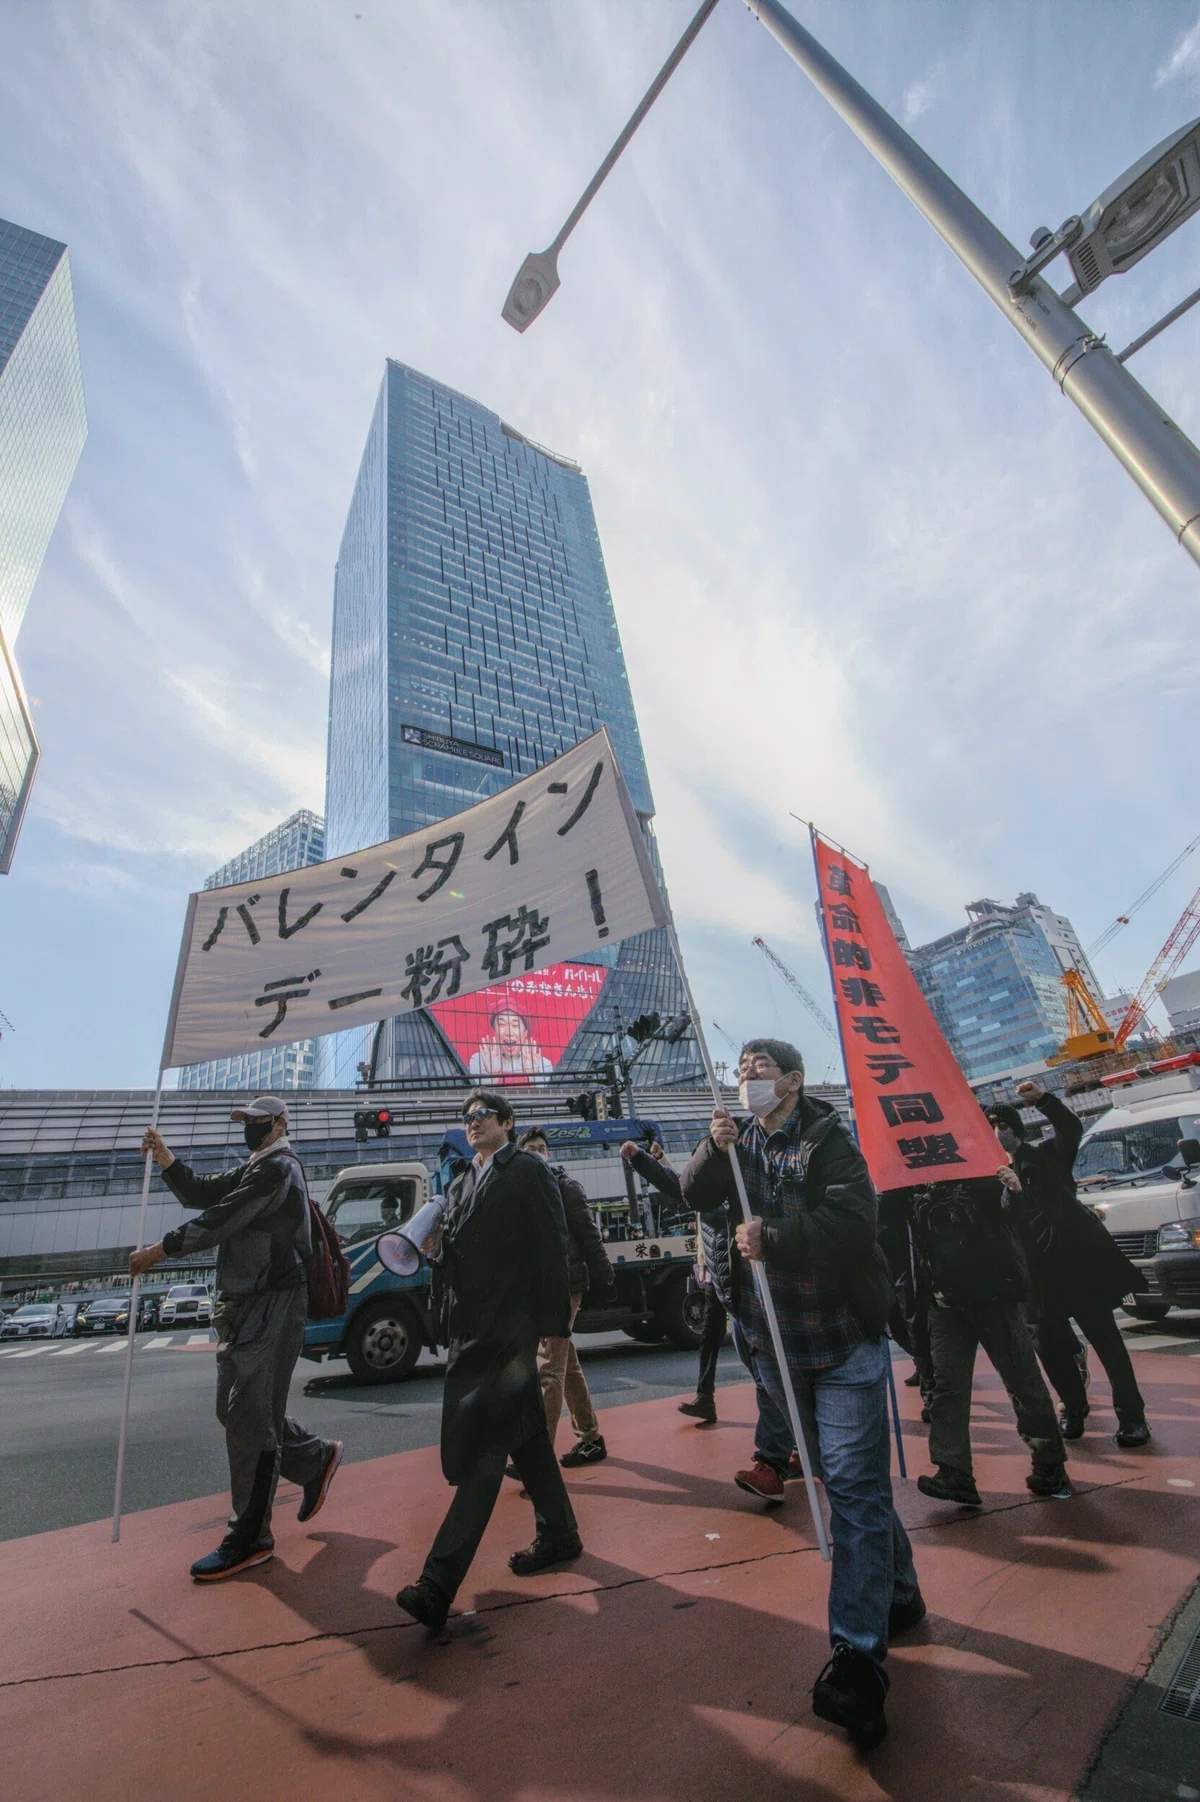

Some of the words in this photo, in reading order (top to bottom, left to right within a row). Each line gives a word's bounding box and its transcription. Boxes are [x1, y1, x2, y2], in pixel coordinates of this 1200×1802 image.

[422, 732, 460, 747] SHIBUYA
[422, 739, 468, 757] SCRAMBLE
[469, 751, 501, 765] SQUARE
[202, 762, 604, 951] バレンタイン
[826, 864, 967, 1170] 革命的非モテ同盟
